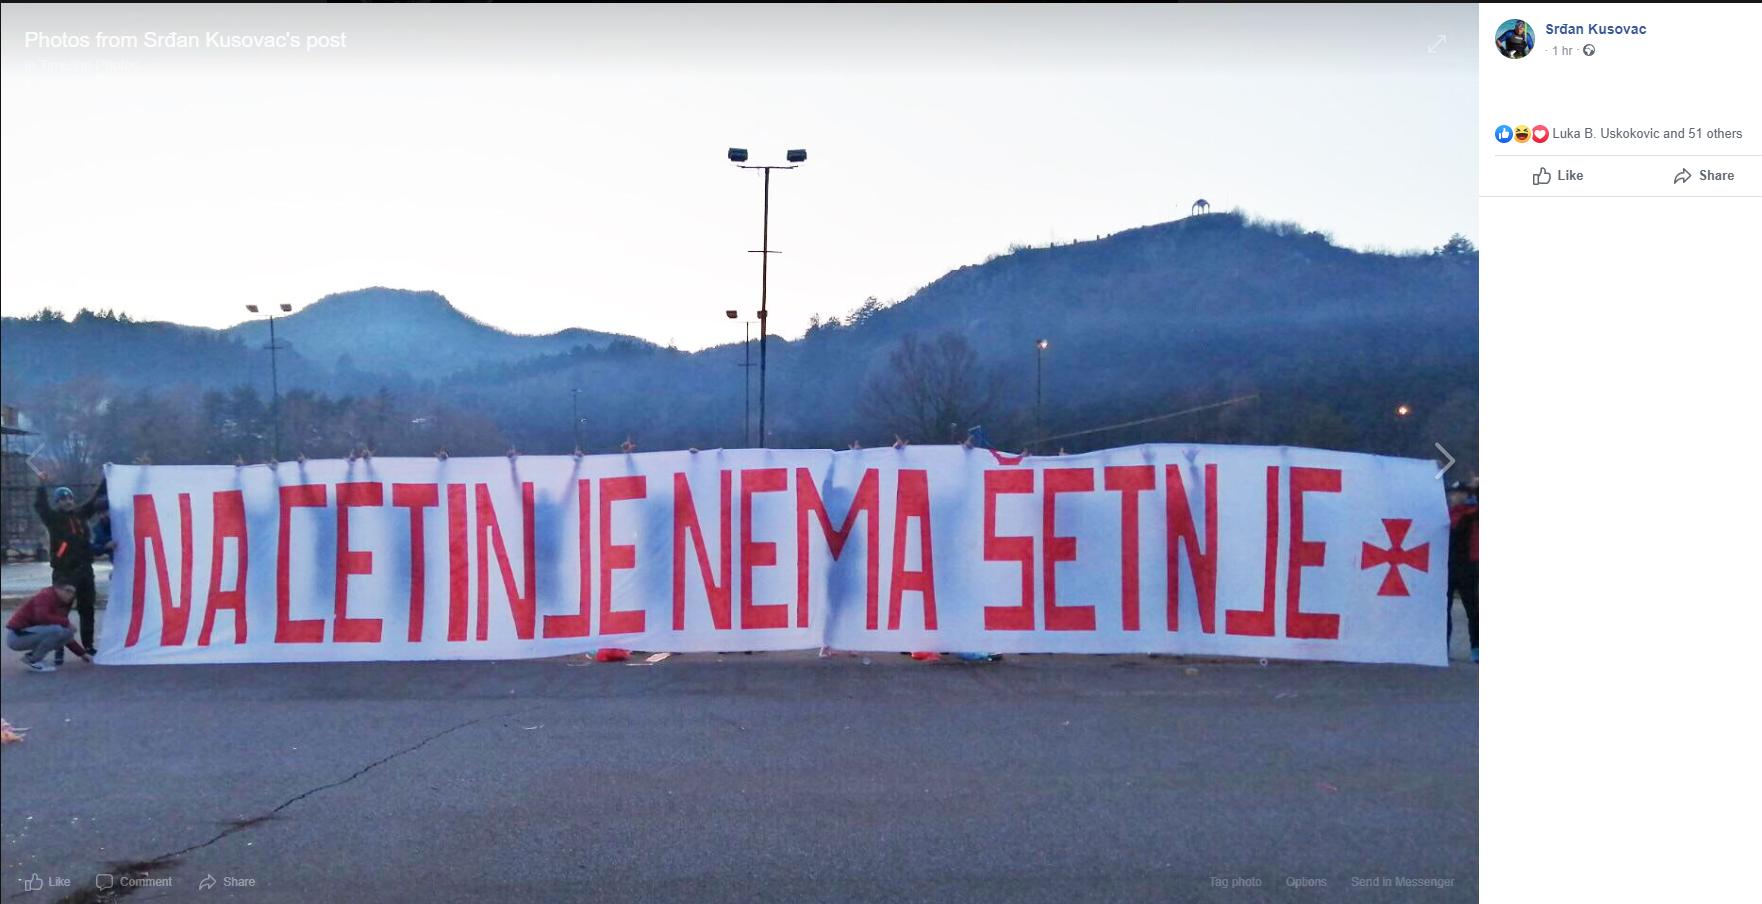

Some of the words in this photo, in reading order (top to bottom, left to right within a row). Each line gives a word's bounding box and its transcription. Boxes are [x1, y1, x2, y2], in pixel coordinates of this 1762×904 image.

[125, 490, 248, 647] NA
[274, 475, 647, 644] CETINJE
[673, 467, 937, 631] NEMA
[983, 448, 1343, 639] ŠETNJE
